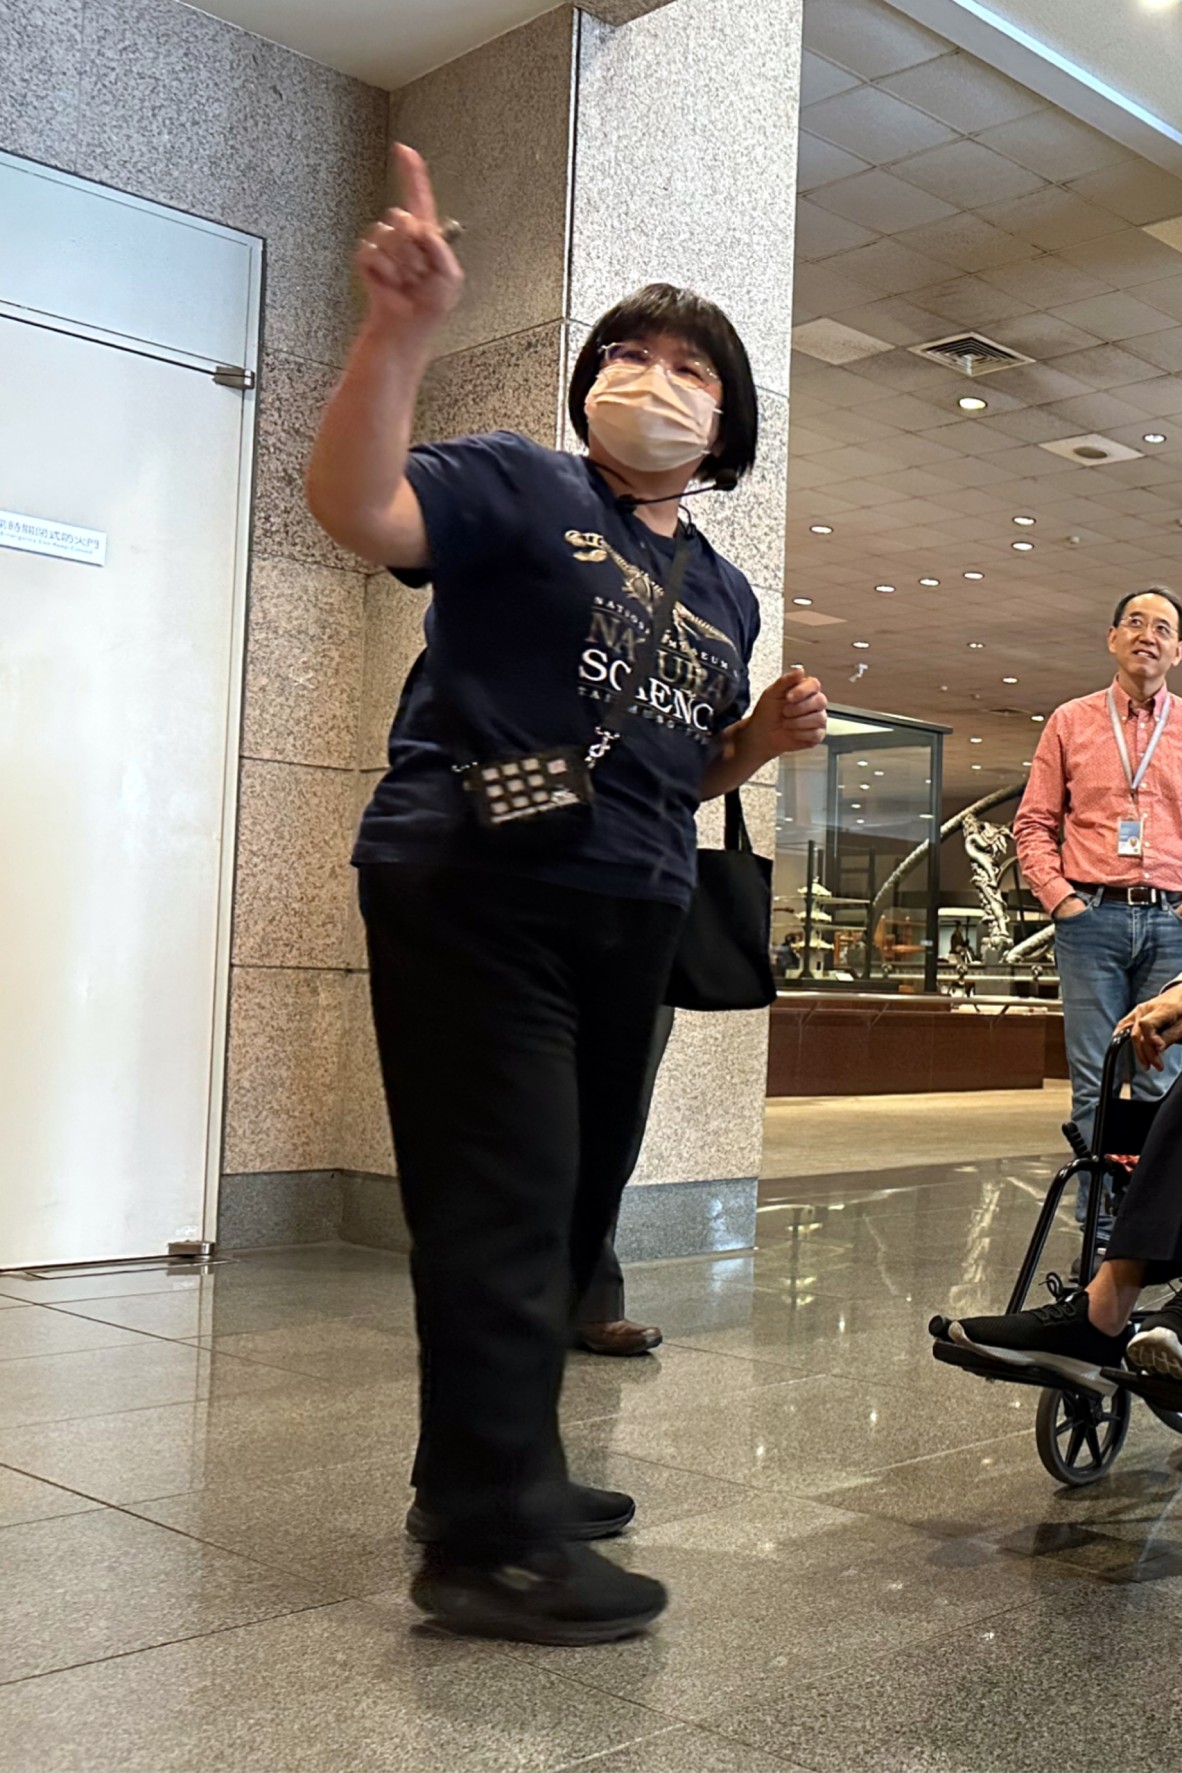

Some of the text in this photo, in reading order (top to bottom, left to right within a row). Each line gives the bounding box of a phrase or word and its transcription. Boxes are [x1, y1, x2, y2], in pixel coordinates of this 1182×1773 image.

[584, 611, 730, 701] NAURA
[593, 596, 651, 635] NATIONA
[578, 648, 714, 731] SCENC
